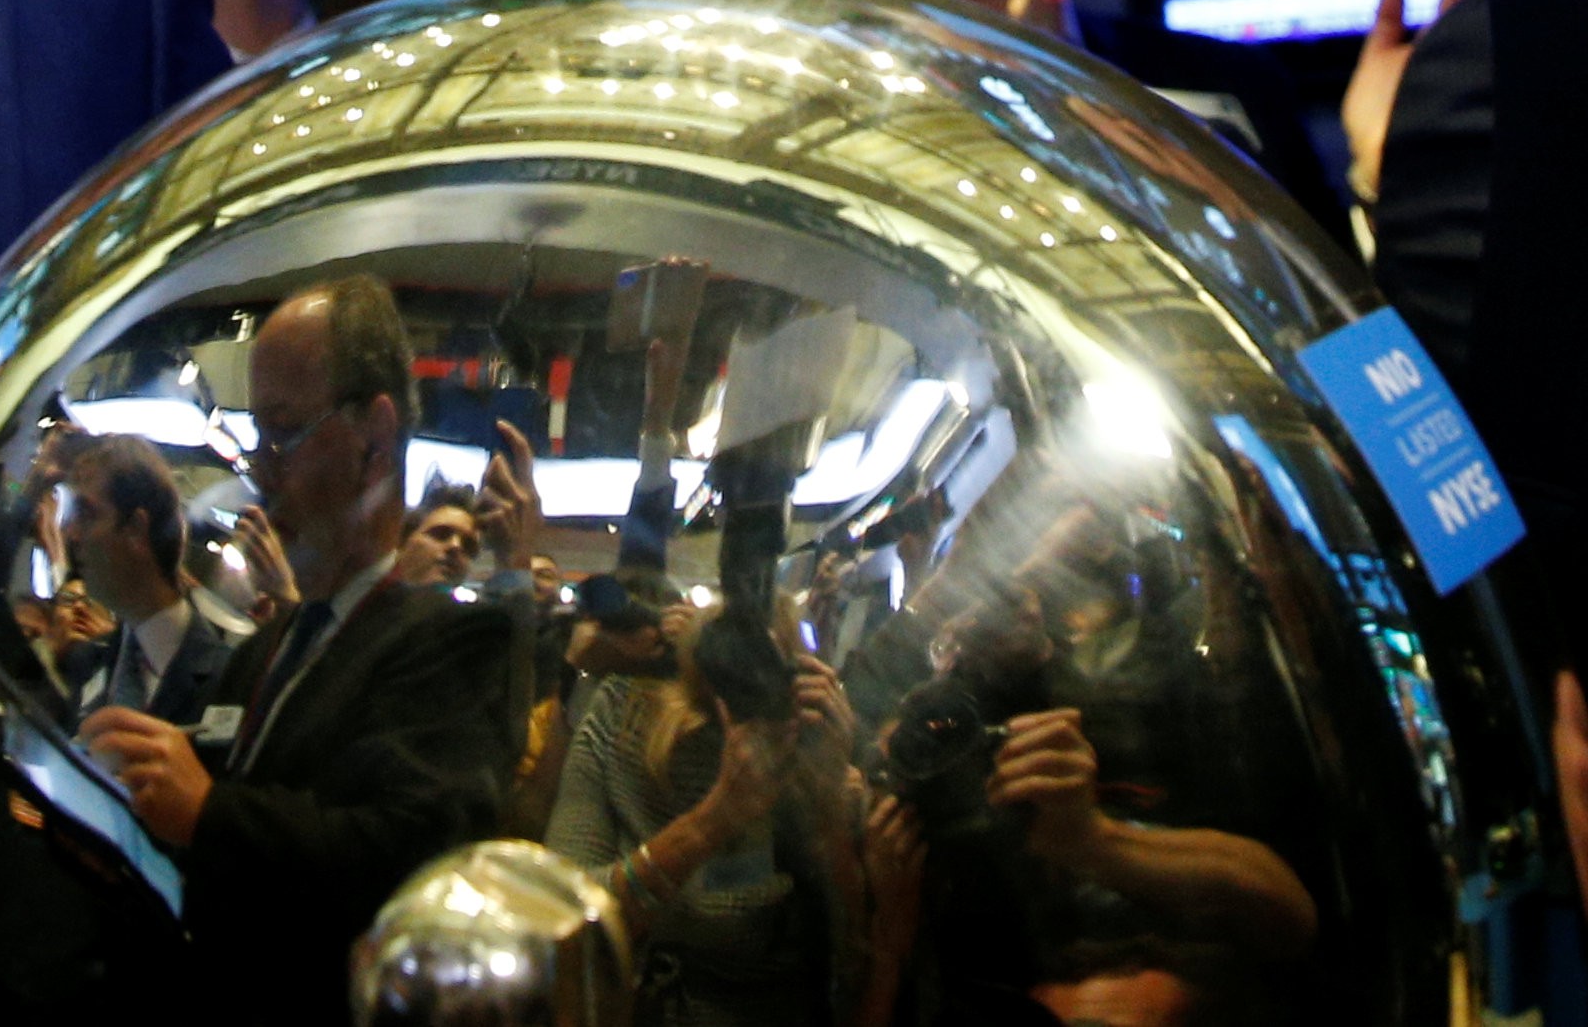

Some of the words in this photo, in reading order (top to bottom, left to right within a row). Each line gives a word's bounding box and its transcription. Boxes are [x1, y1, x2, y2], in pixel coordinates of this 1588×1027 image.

[1365, 348, 1422, 404] NIO
[1395, 408, 1463, 468] LISTED
[1428, 460, 1501, 536] NYSE
